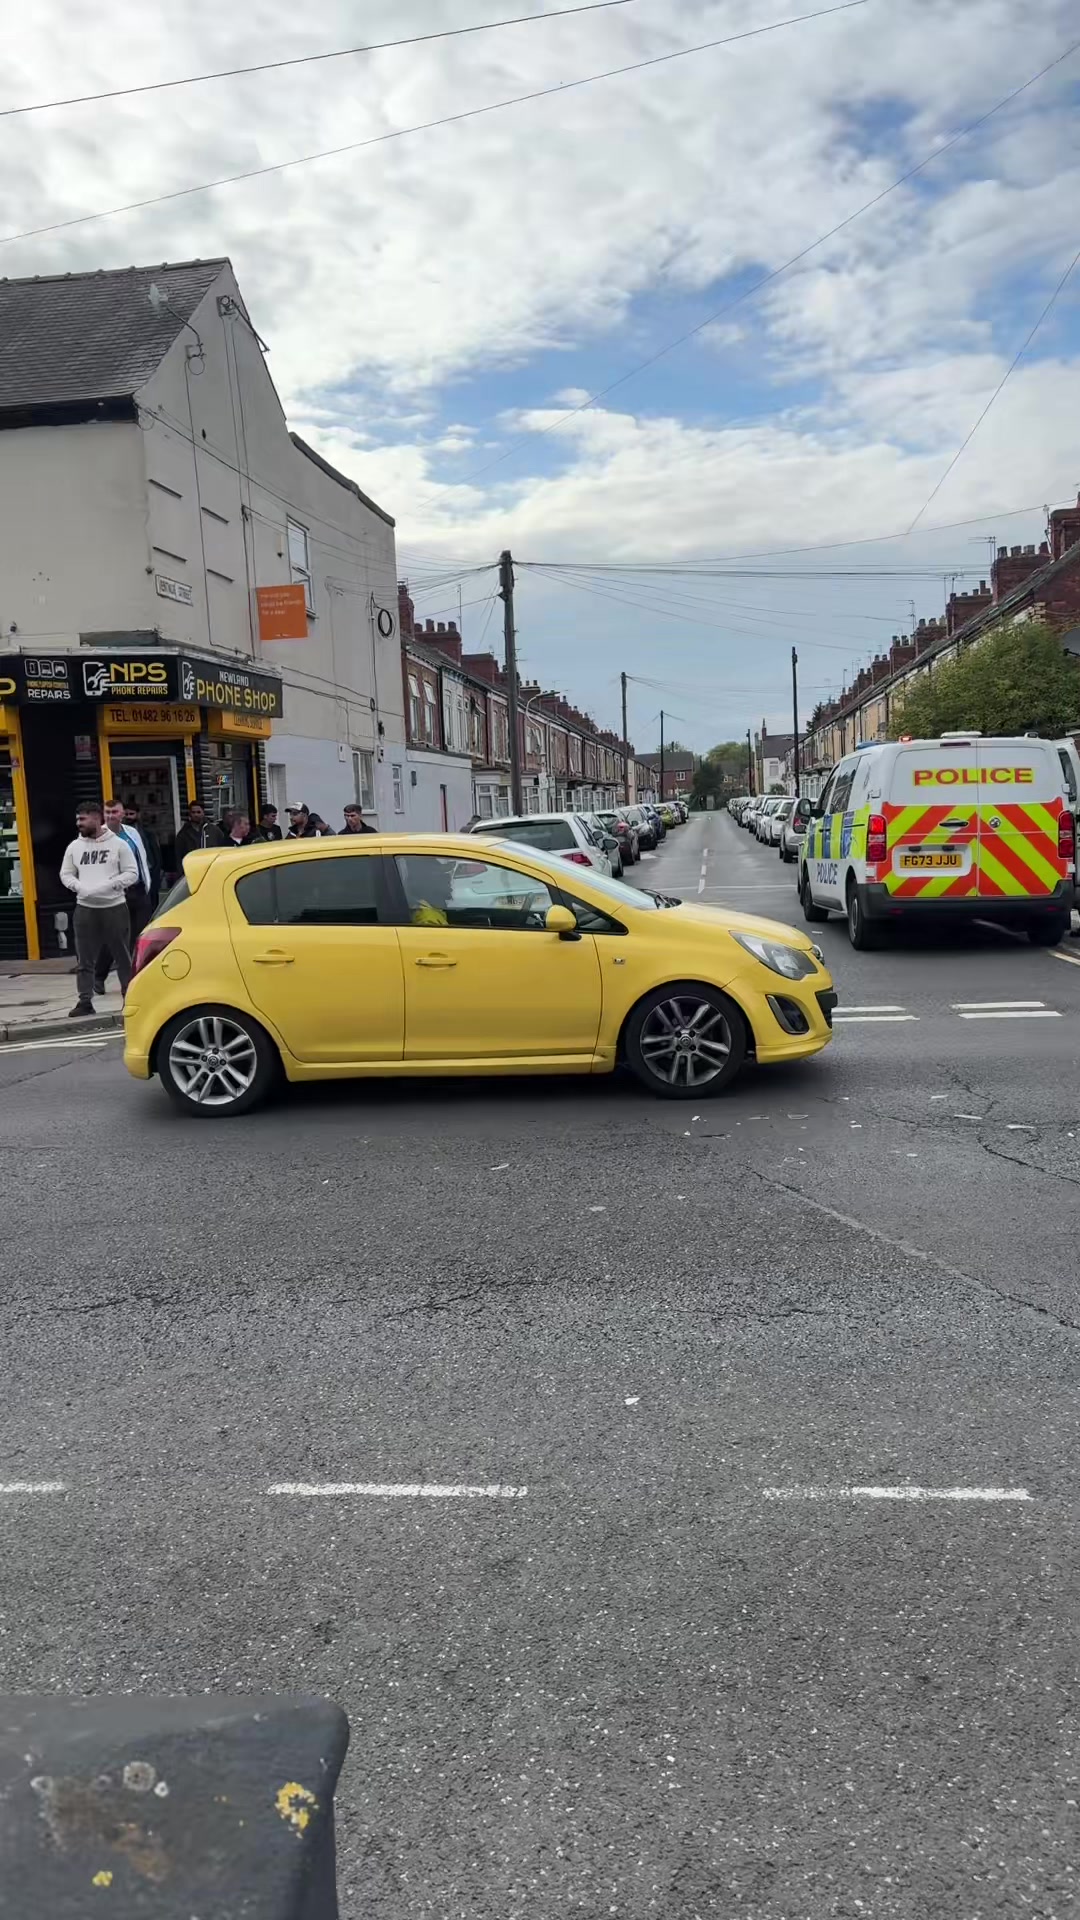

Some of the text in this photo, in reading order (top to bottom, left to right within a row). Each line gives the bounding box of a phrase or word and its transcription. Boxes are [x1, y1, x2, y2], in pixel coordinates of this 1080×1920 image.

[109, 662, 167, 682] NPS
[219, 670, 249, 687] NEWLAND
[27, 688, 71, 699] REPAIRS
[111, 685, 168, 695] PHONE REPAIRS
[196, 679, 276, 712] PHONE SHOP
[132, 710, 158, 722] 01482
[160, 710, 172, 722] 96
[184, 711, 196, 722] 26
[914, 767, 1033, 787] POLICE
[904, 854, 957, 866] FG73 JJU
[816, 862, 838, 885] POLICE
